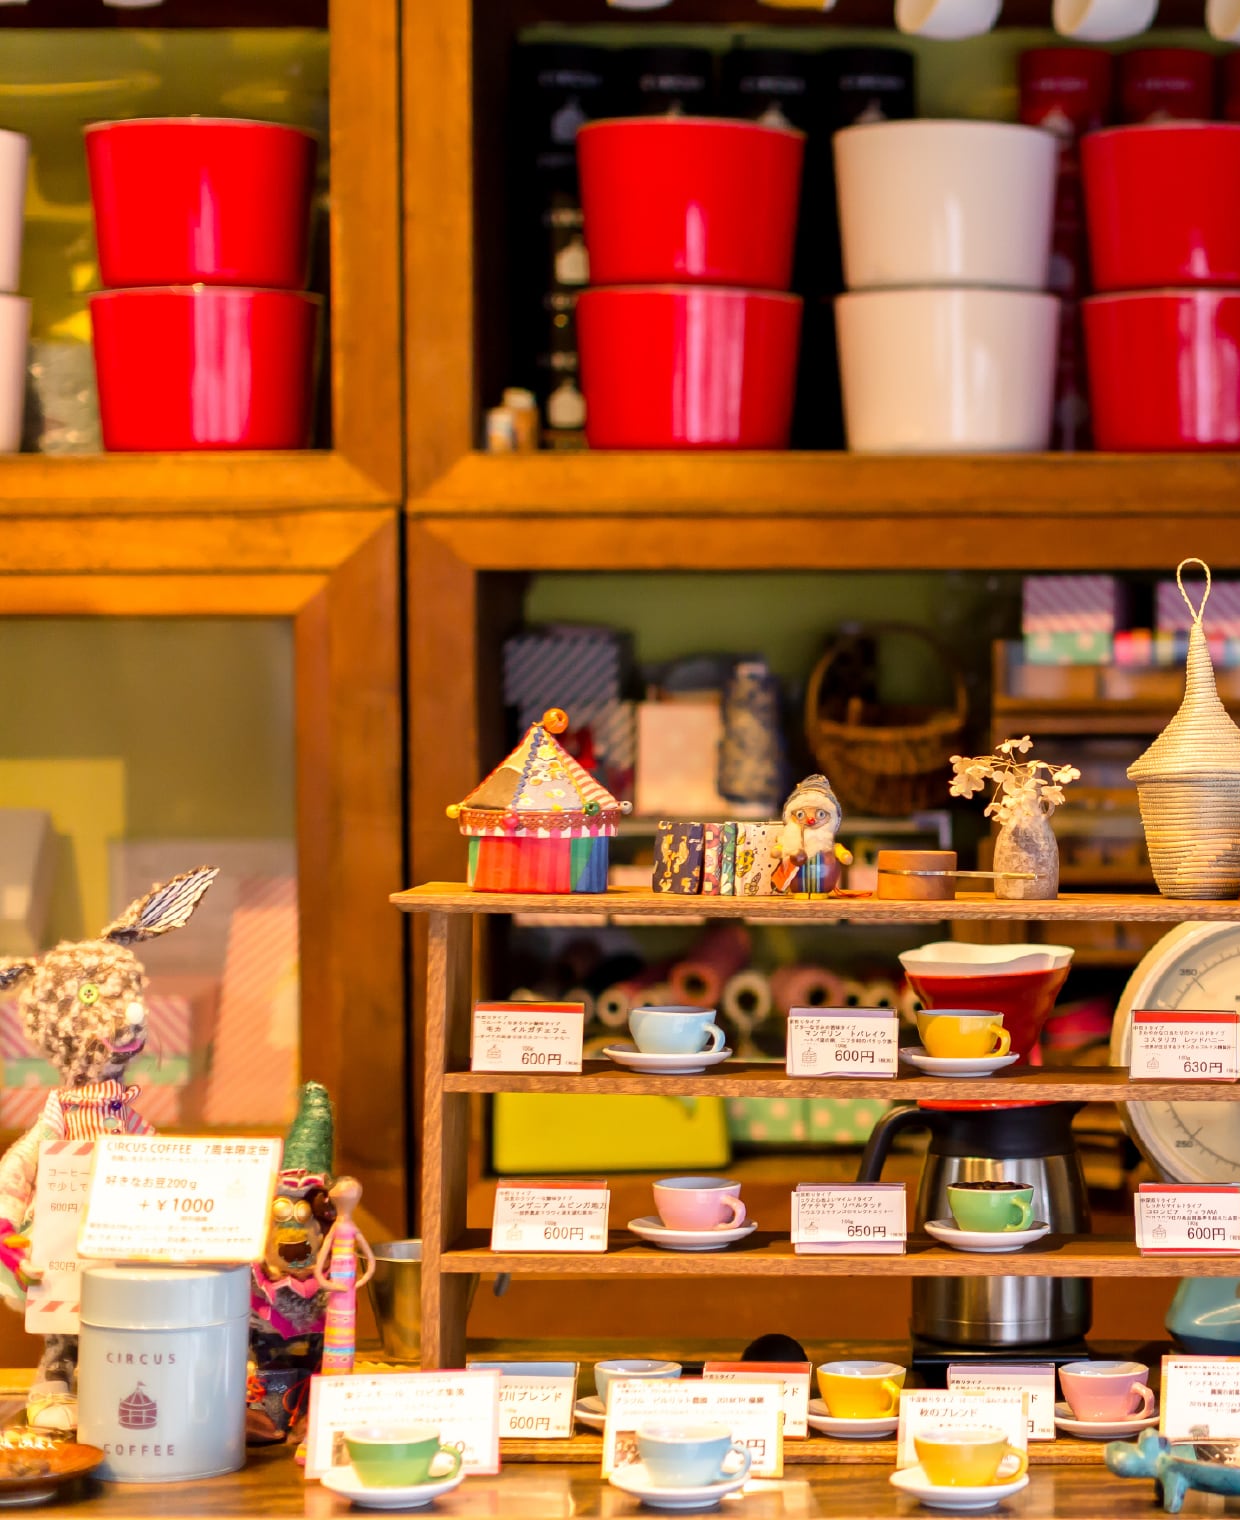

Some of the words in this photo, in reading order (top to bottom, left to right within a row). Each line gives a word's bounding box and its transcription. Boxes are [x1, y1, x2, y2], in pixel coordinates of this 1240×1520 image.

[521, 1052, 562, 1065] 600円
[835, 1050, 875, 1063] 600円
[1183, 1061, 1224, 1074] 630円
[544, 1226, 584, 1240] 600円
[847, 1226, 887, 1238] 650円
[1187, 1228, 1226, 1240] 600円
[105, 1352, 176, 1366] CIRCUS
[509, 1416, 551, 1431] 600円
[103, 1443, 175, 1456] COFFEE
